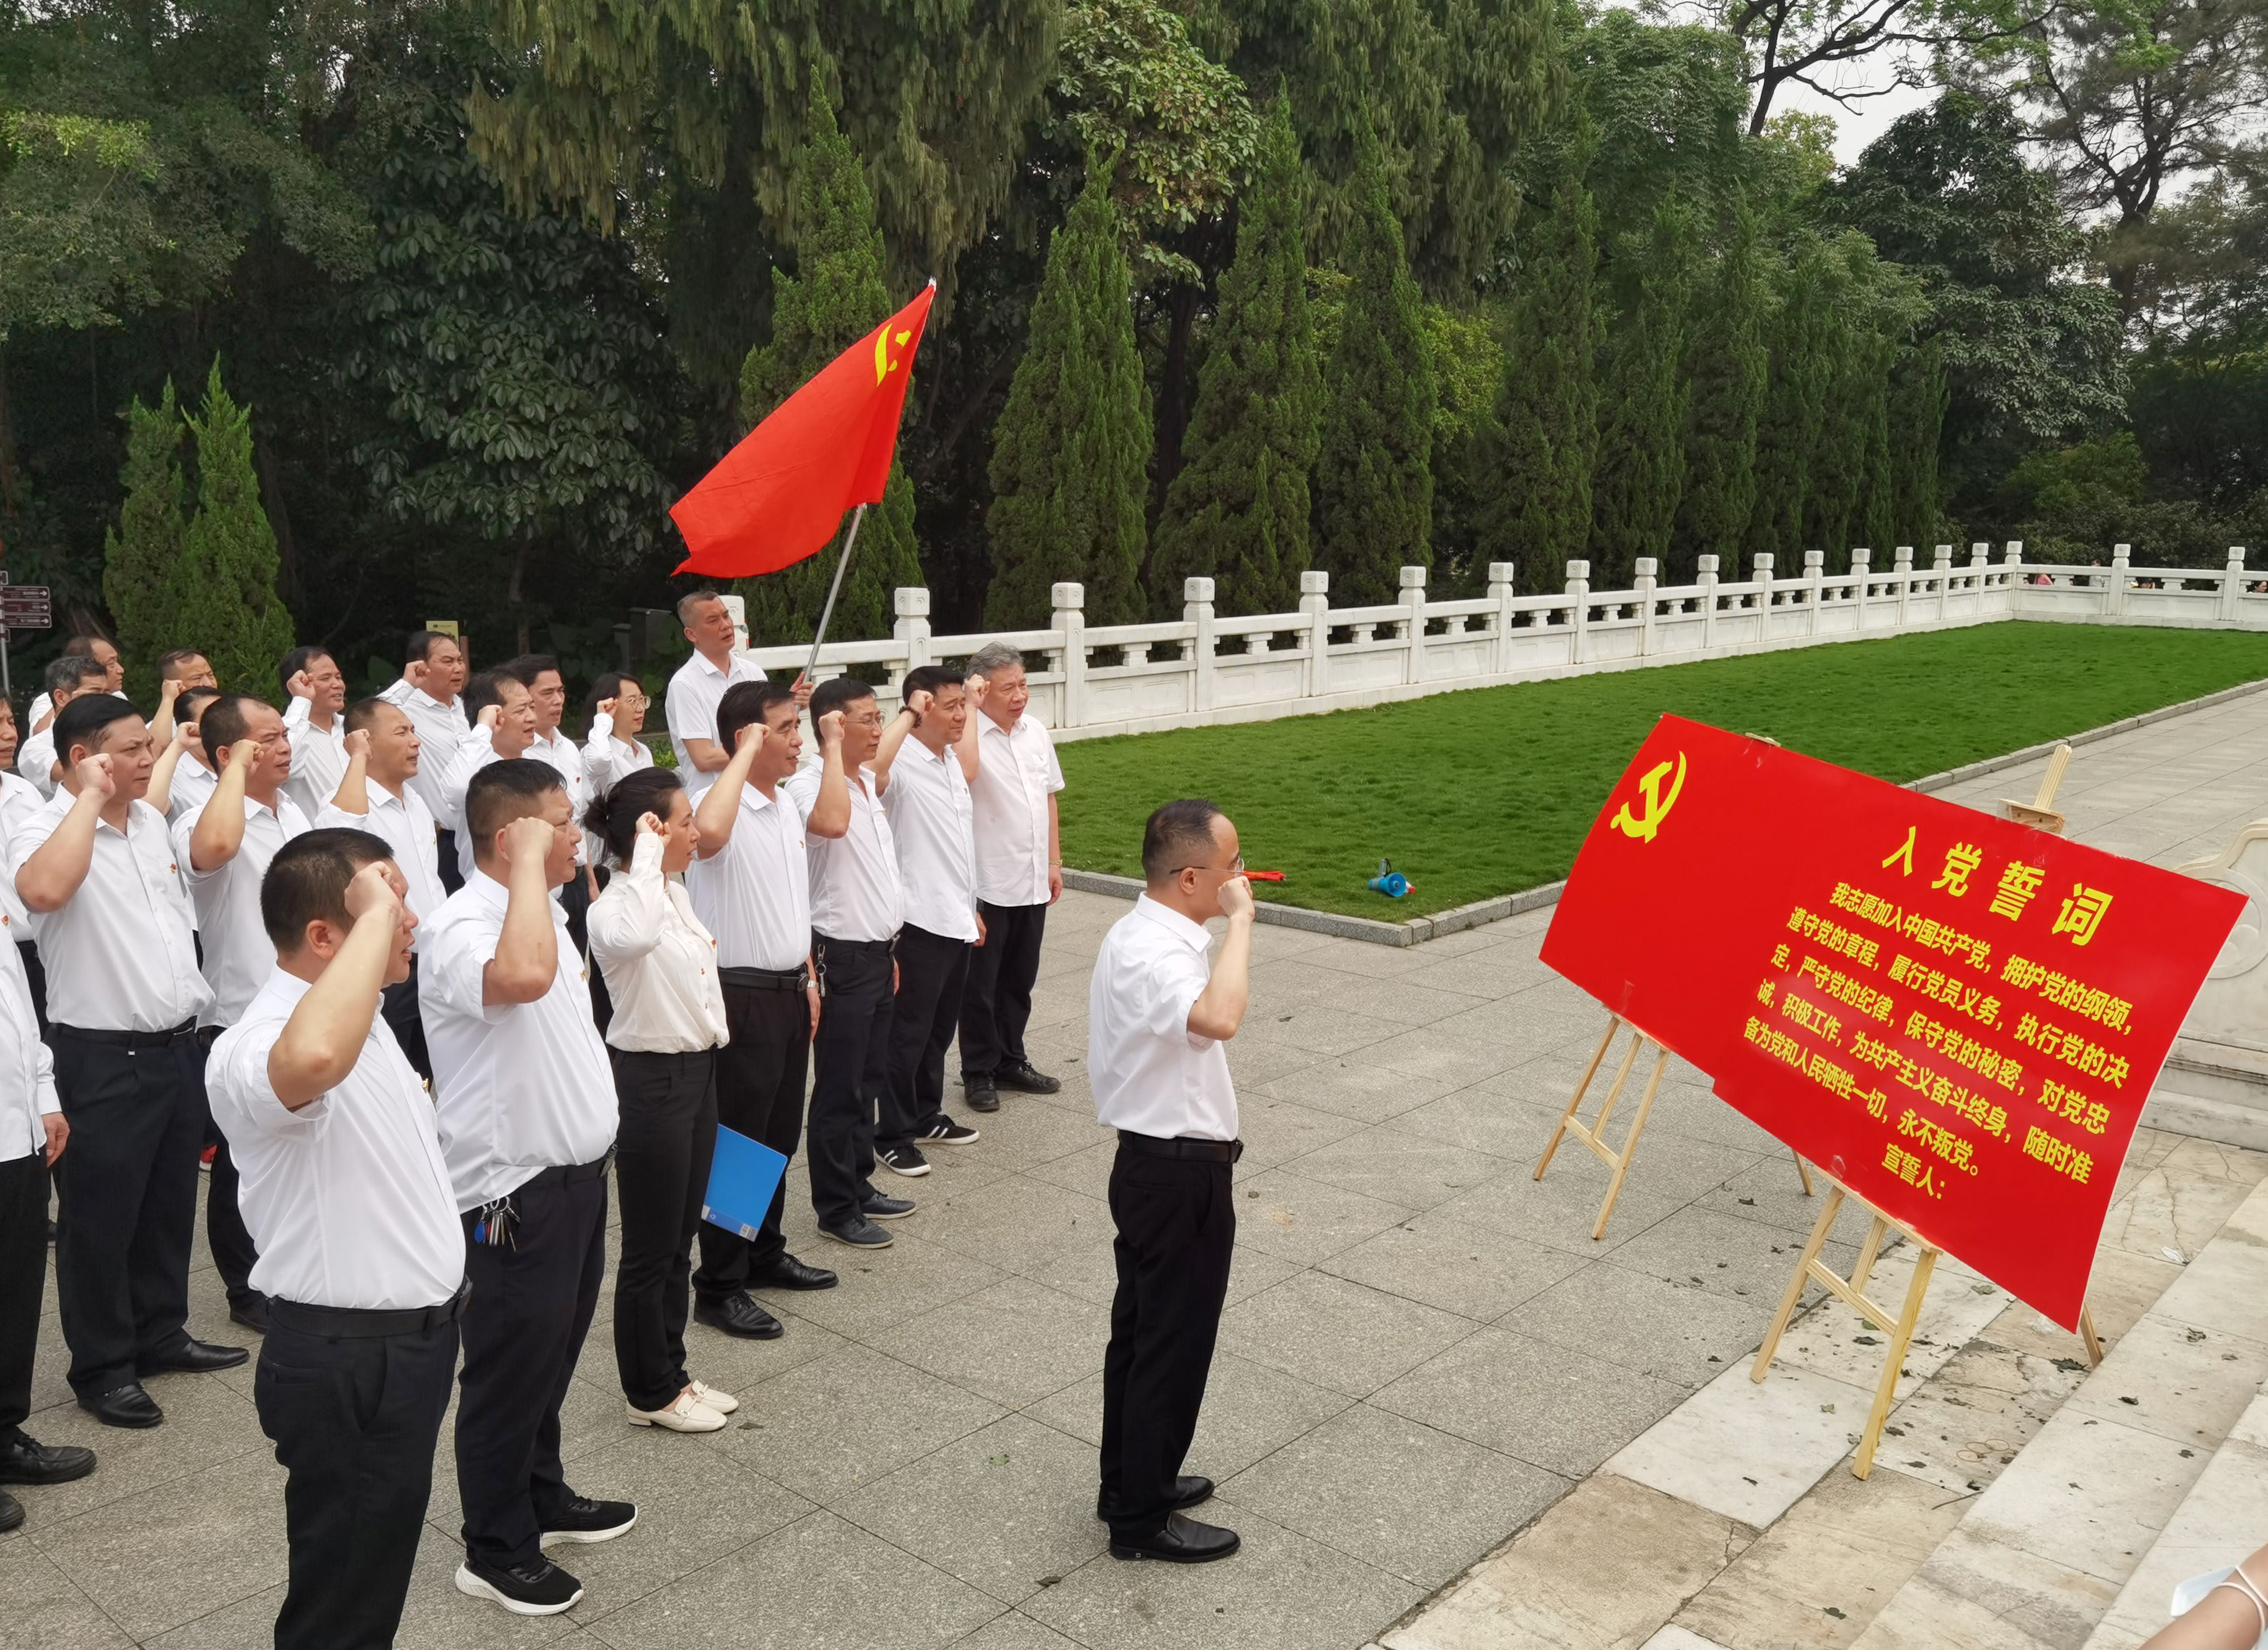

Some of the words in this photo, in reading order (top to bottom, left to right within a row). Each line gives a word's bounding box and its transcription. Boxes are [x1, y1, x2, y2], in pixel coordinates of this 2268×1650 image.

[1830, 882, 2133, 1036] 我志愿加入中国共产党，拥护党的纲领，
[1882, 826, 2113, 946] 入党誓词
[1771, 944, 2111, 1135] 定，严守党的纪律，保守党的秘密，对党忠
[1787, 906, 2130, 1089] 遵守党的章程，履行党员义务，执行党的决
[1743, 1016, 1978, 1176] 备为党和人民牺牲一切，永不叛党。
[1757, 978, 2094, 1184] 诚，积极工作，为共产主义奋斗终身，随时准
[1882, 1143, 1945, 1199] 宣誓人：
